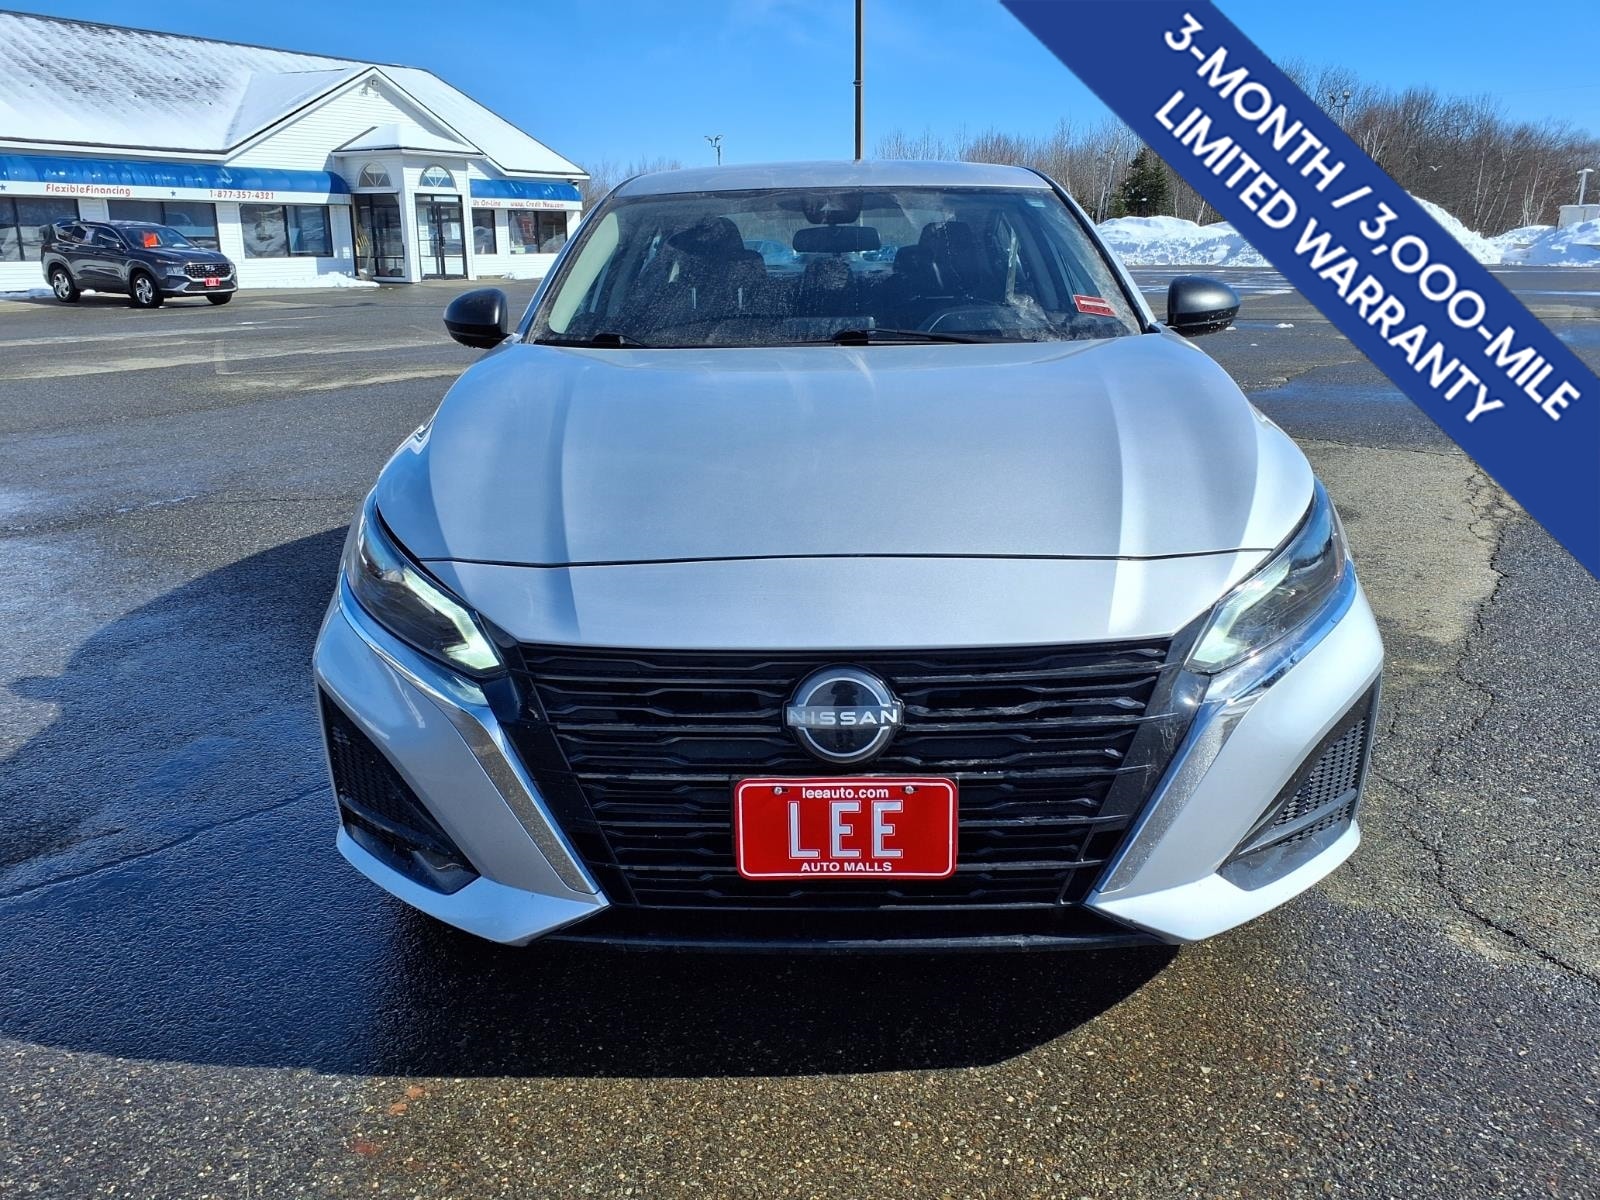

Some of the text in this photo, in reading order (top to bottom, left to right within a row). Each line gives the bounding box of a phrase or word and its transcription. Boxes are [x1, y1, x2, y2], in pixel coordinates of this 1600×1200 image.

[209, 189, 275, 200] 1-877-357-4321
[788, 707, 898, 726] NISSAN
[802, 787, 889, 799] leeauto.com
[788, 800, 904, 859] LEE
[801, 862, 893, 872] AUTO MALLS
